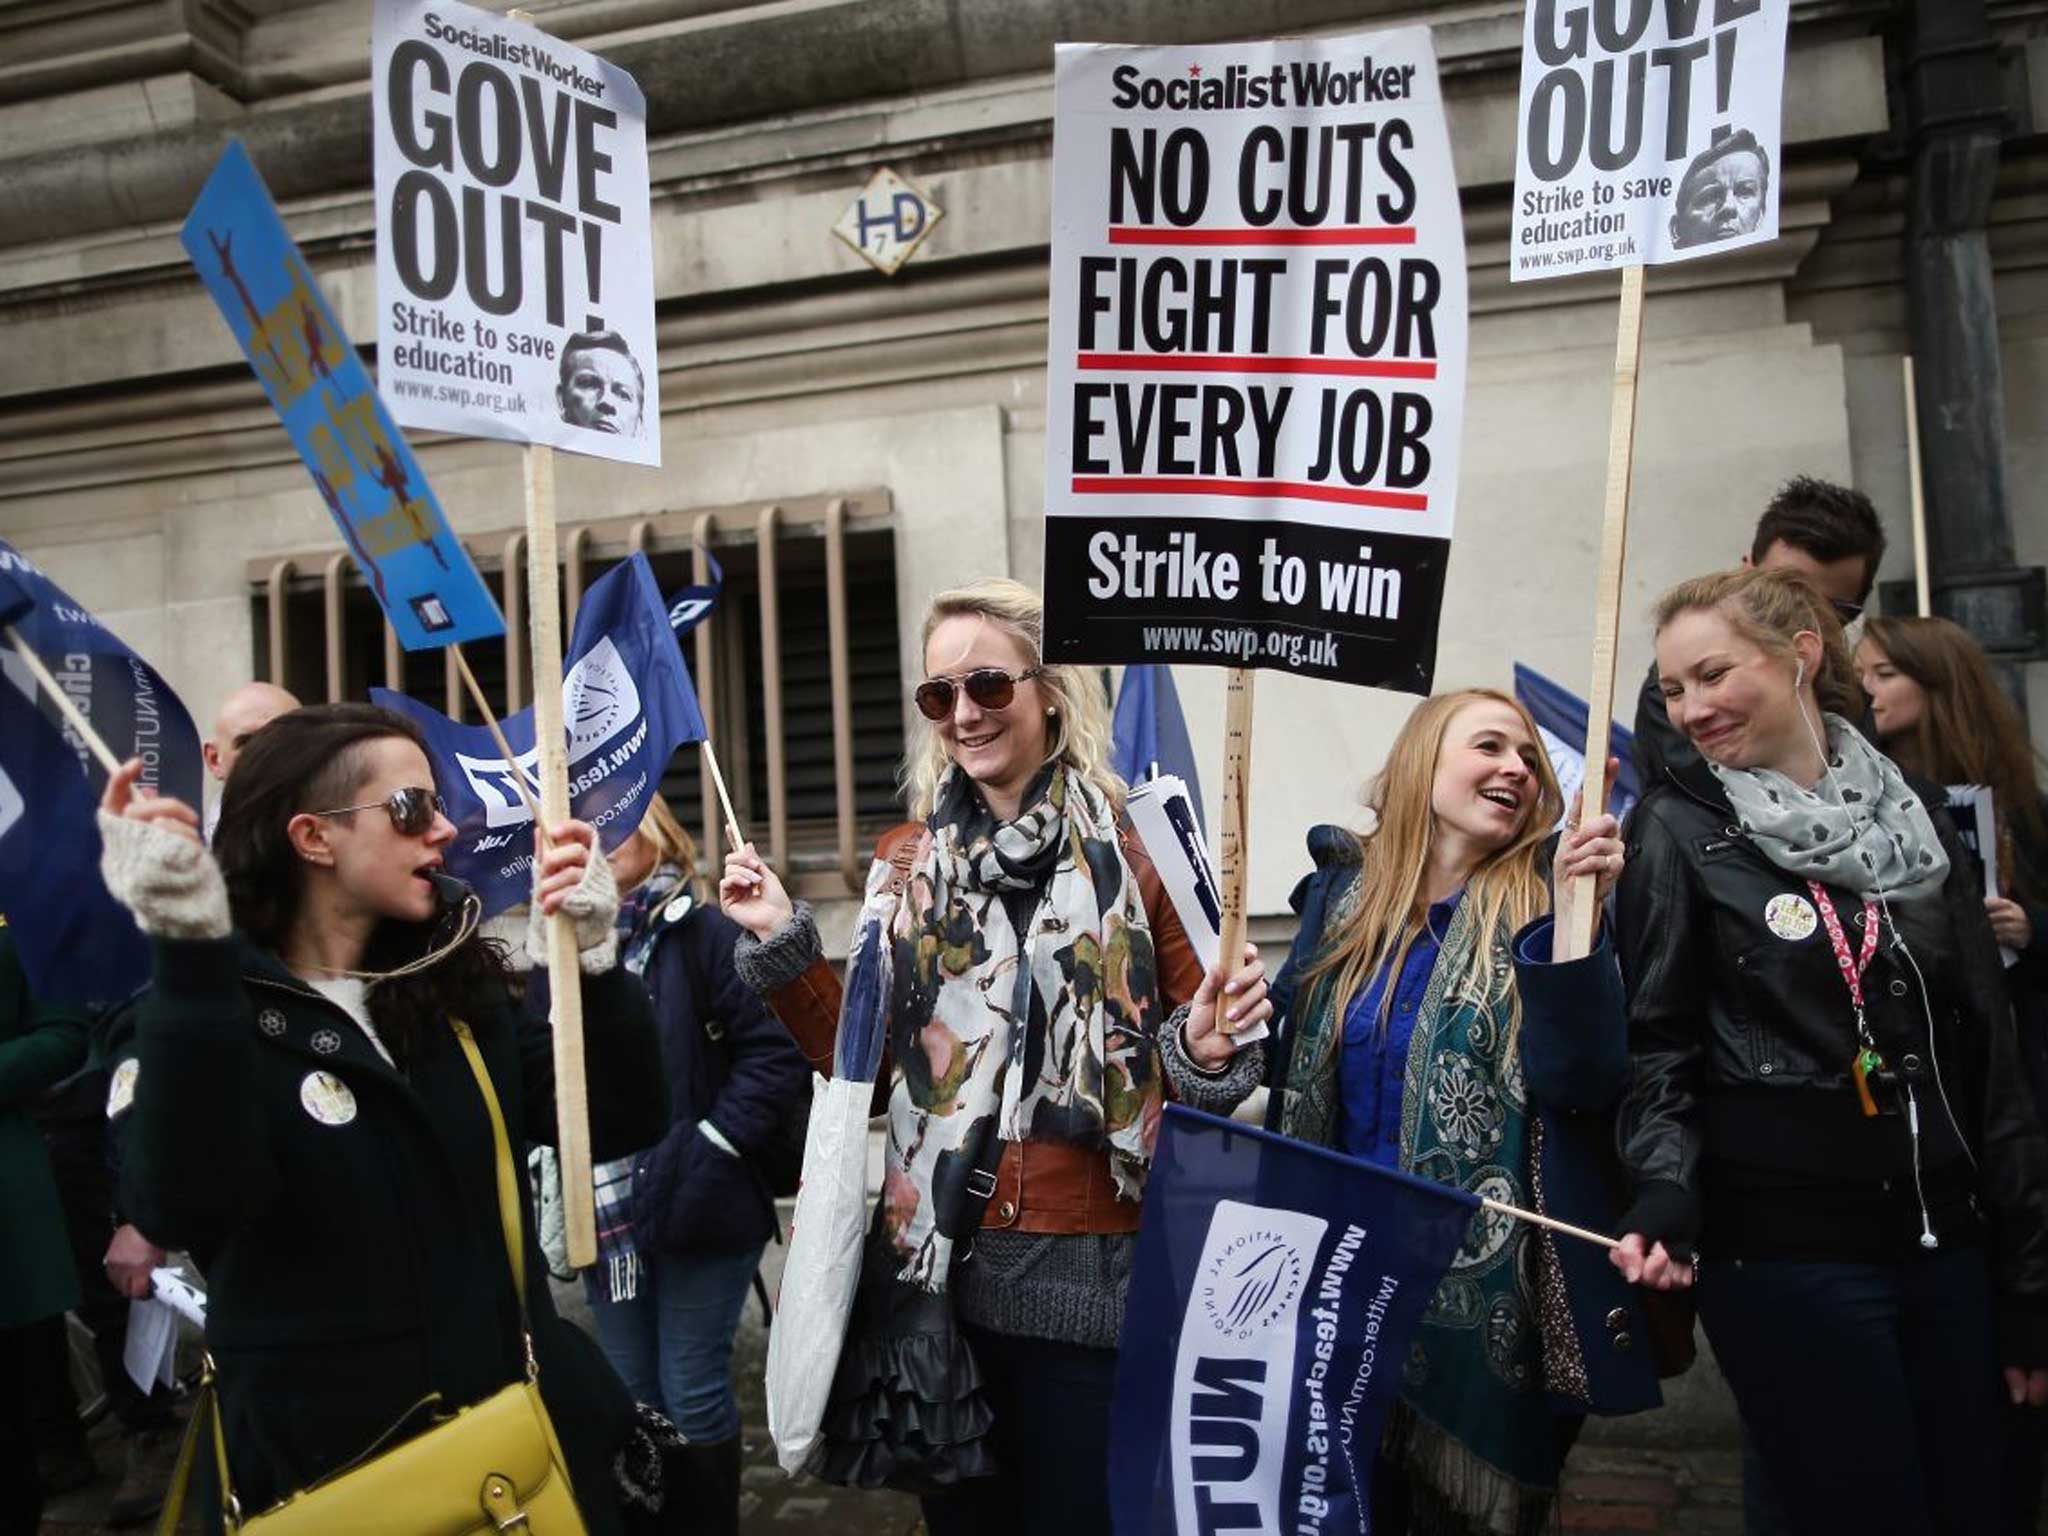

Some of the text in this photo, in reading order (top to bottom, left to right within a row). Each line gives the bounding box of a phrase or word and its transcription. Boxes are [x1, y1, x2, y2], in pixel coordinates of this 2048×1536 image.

[424, 12, 605, 98] Socialist Worker
[1111, 56, 1416, 110] Socialist Worker
[388, 39, 621, 224] GOVE
[1527, 26, 1738, 182] OUT!
[1108, 117, 1417, 227] NO CUTS
[1523, 177, 1673, 217] Strike to save
[391, 169, 605, 333] OUT!
[1519, 236, 1636, 270] www.swp.org.uk
[1521, 210, 1626, 246] education
[393, 301, 556, 361] Strike to save
[1078, 256, 1441, 358] FIGHT FOR
[393, 341, 513, 386] education
[393, 379, 527, 414] www.swp.org.uk
[1072, 383, 1432, 489] EVERY JOB
[1088, 531, 1402, 620] Strike to win
[1143, 625, 1338, 667] www.swp.org.uk
